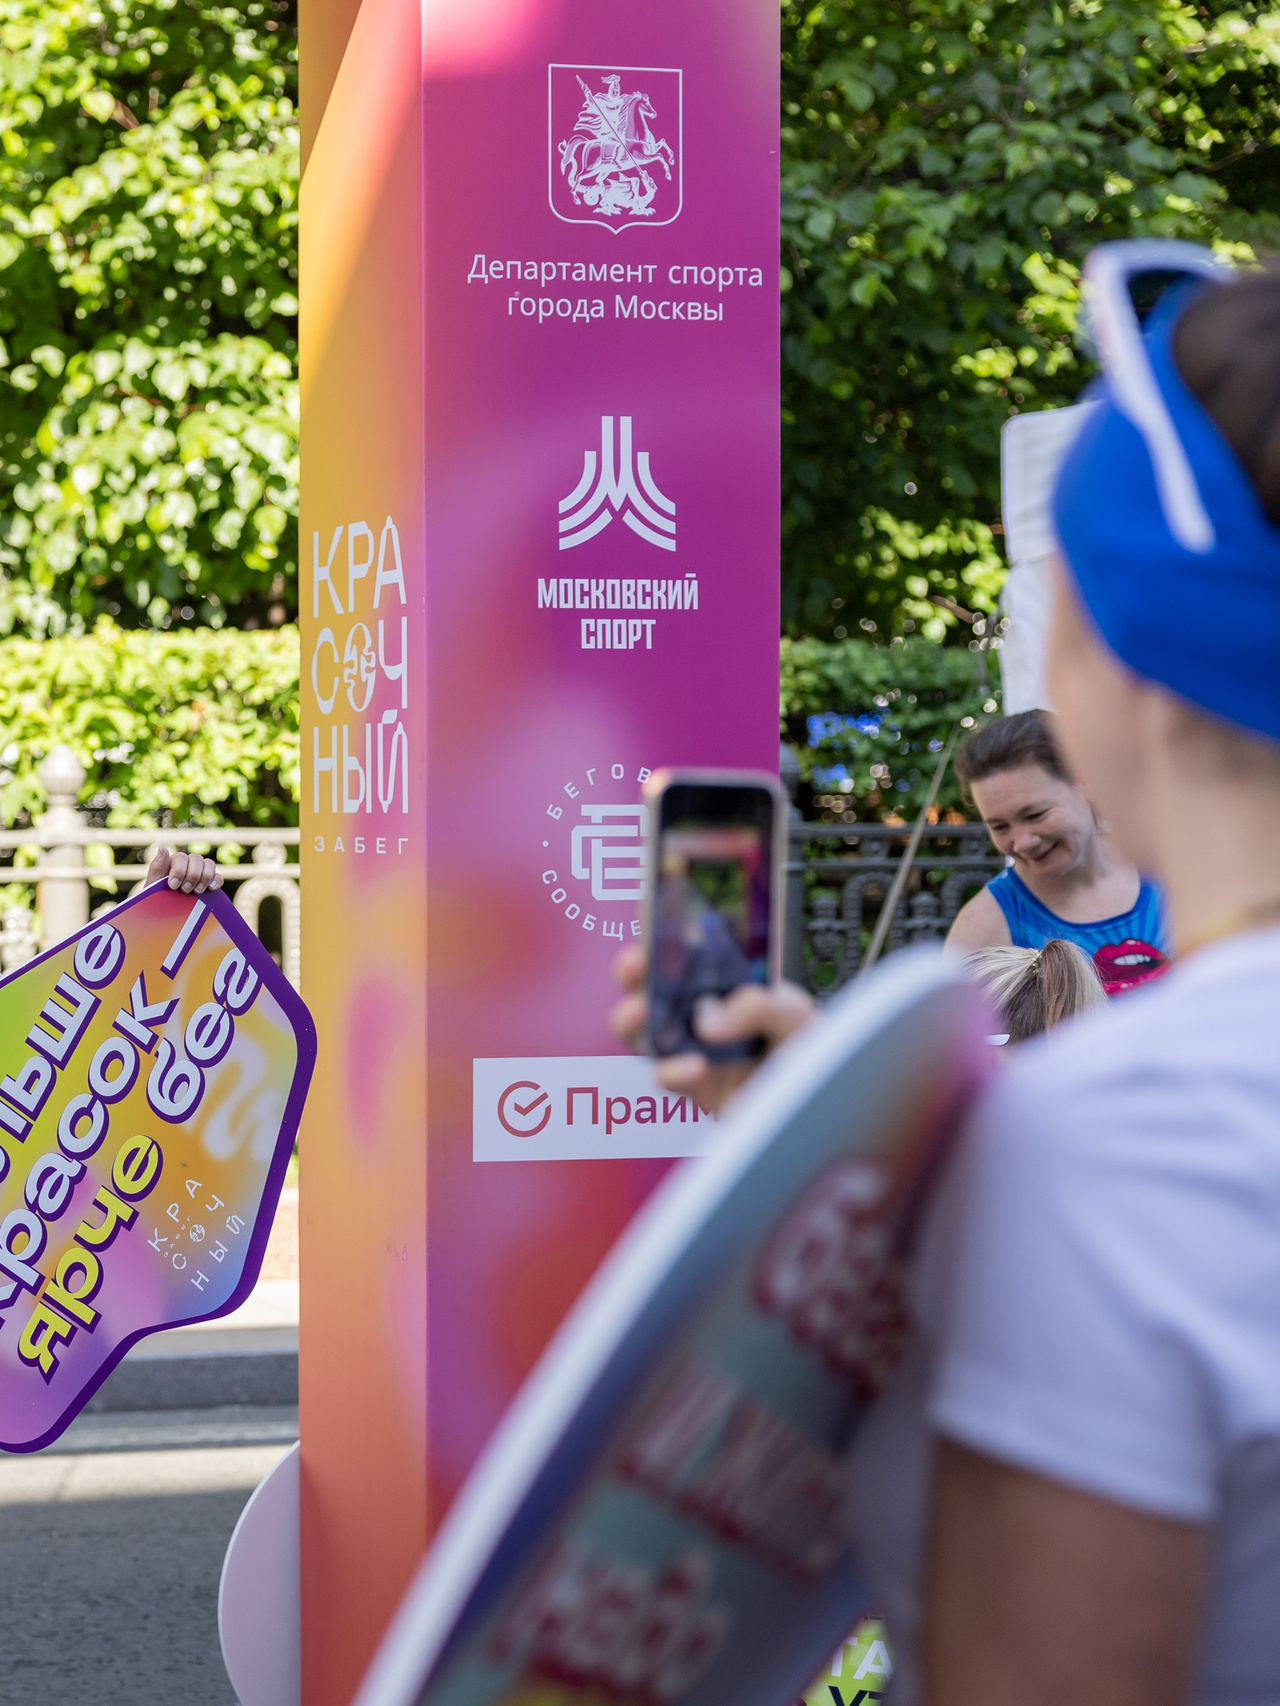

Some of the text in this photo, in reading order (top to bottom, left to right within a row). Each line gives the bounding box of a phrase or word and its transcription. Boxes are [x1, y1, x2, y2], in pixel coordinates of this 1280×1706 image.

[467, 253, 763, 291] Департамент спорта
[507, 294, 723, 323] города Москвы
[313, 515, 407, 618] КРА
[537, 572, 698, 610] МОСКОВСКИЙ
[581, 618, 656, 649] СПОРТ
[313, 709, 408, 813] НЫЙ
[546, 763, 652, 820] БЕГОВ
[313, 836, 409, 854] ЗАБЕГ
[542, 869, 642, 941] СООБЩЕ
[17, 947, 264, 1384] ярче бег
[147, 1179, 202, 1252] КРА
[191, 1214, 245, 1291] НЫЙ
